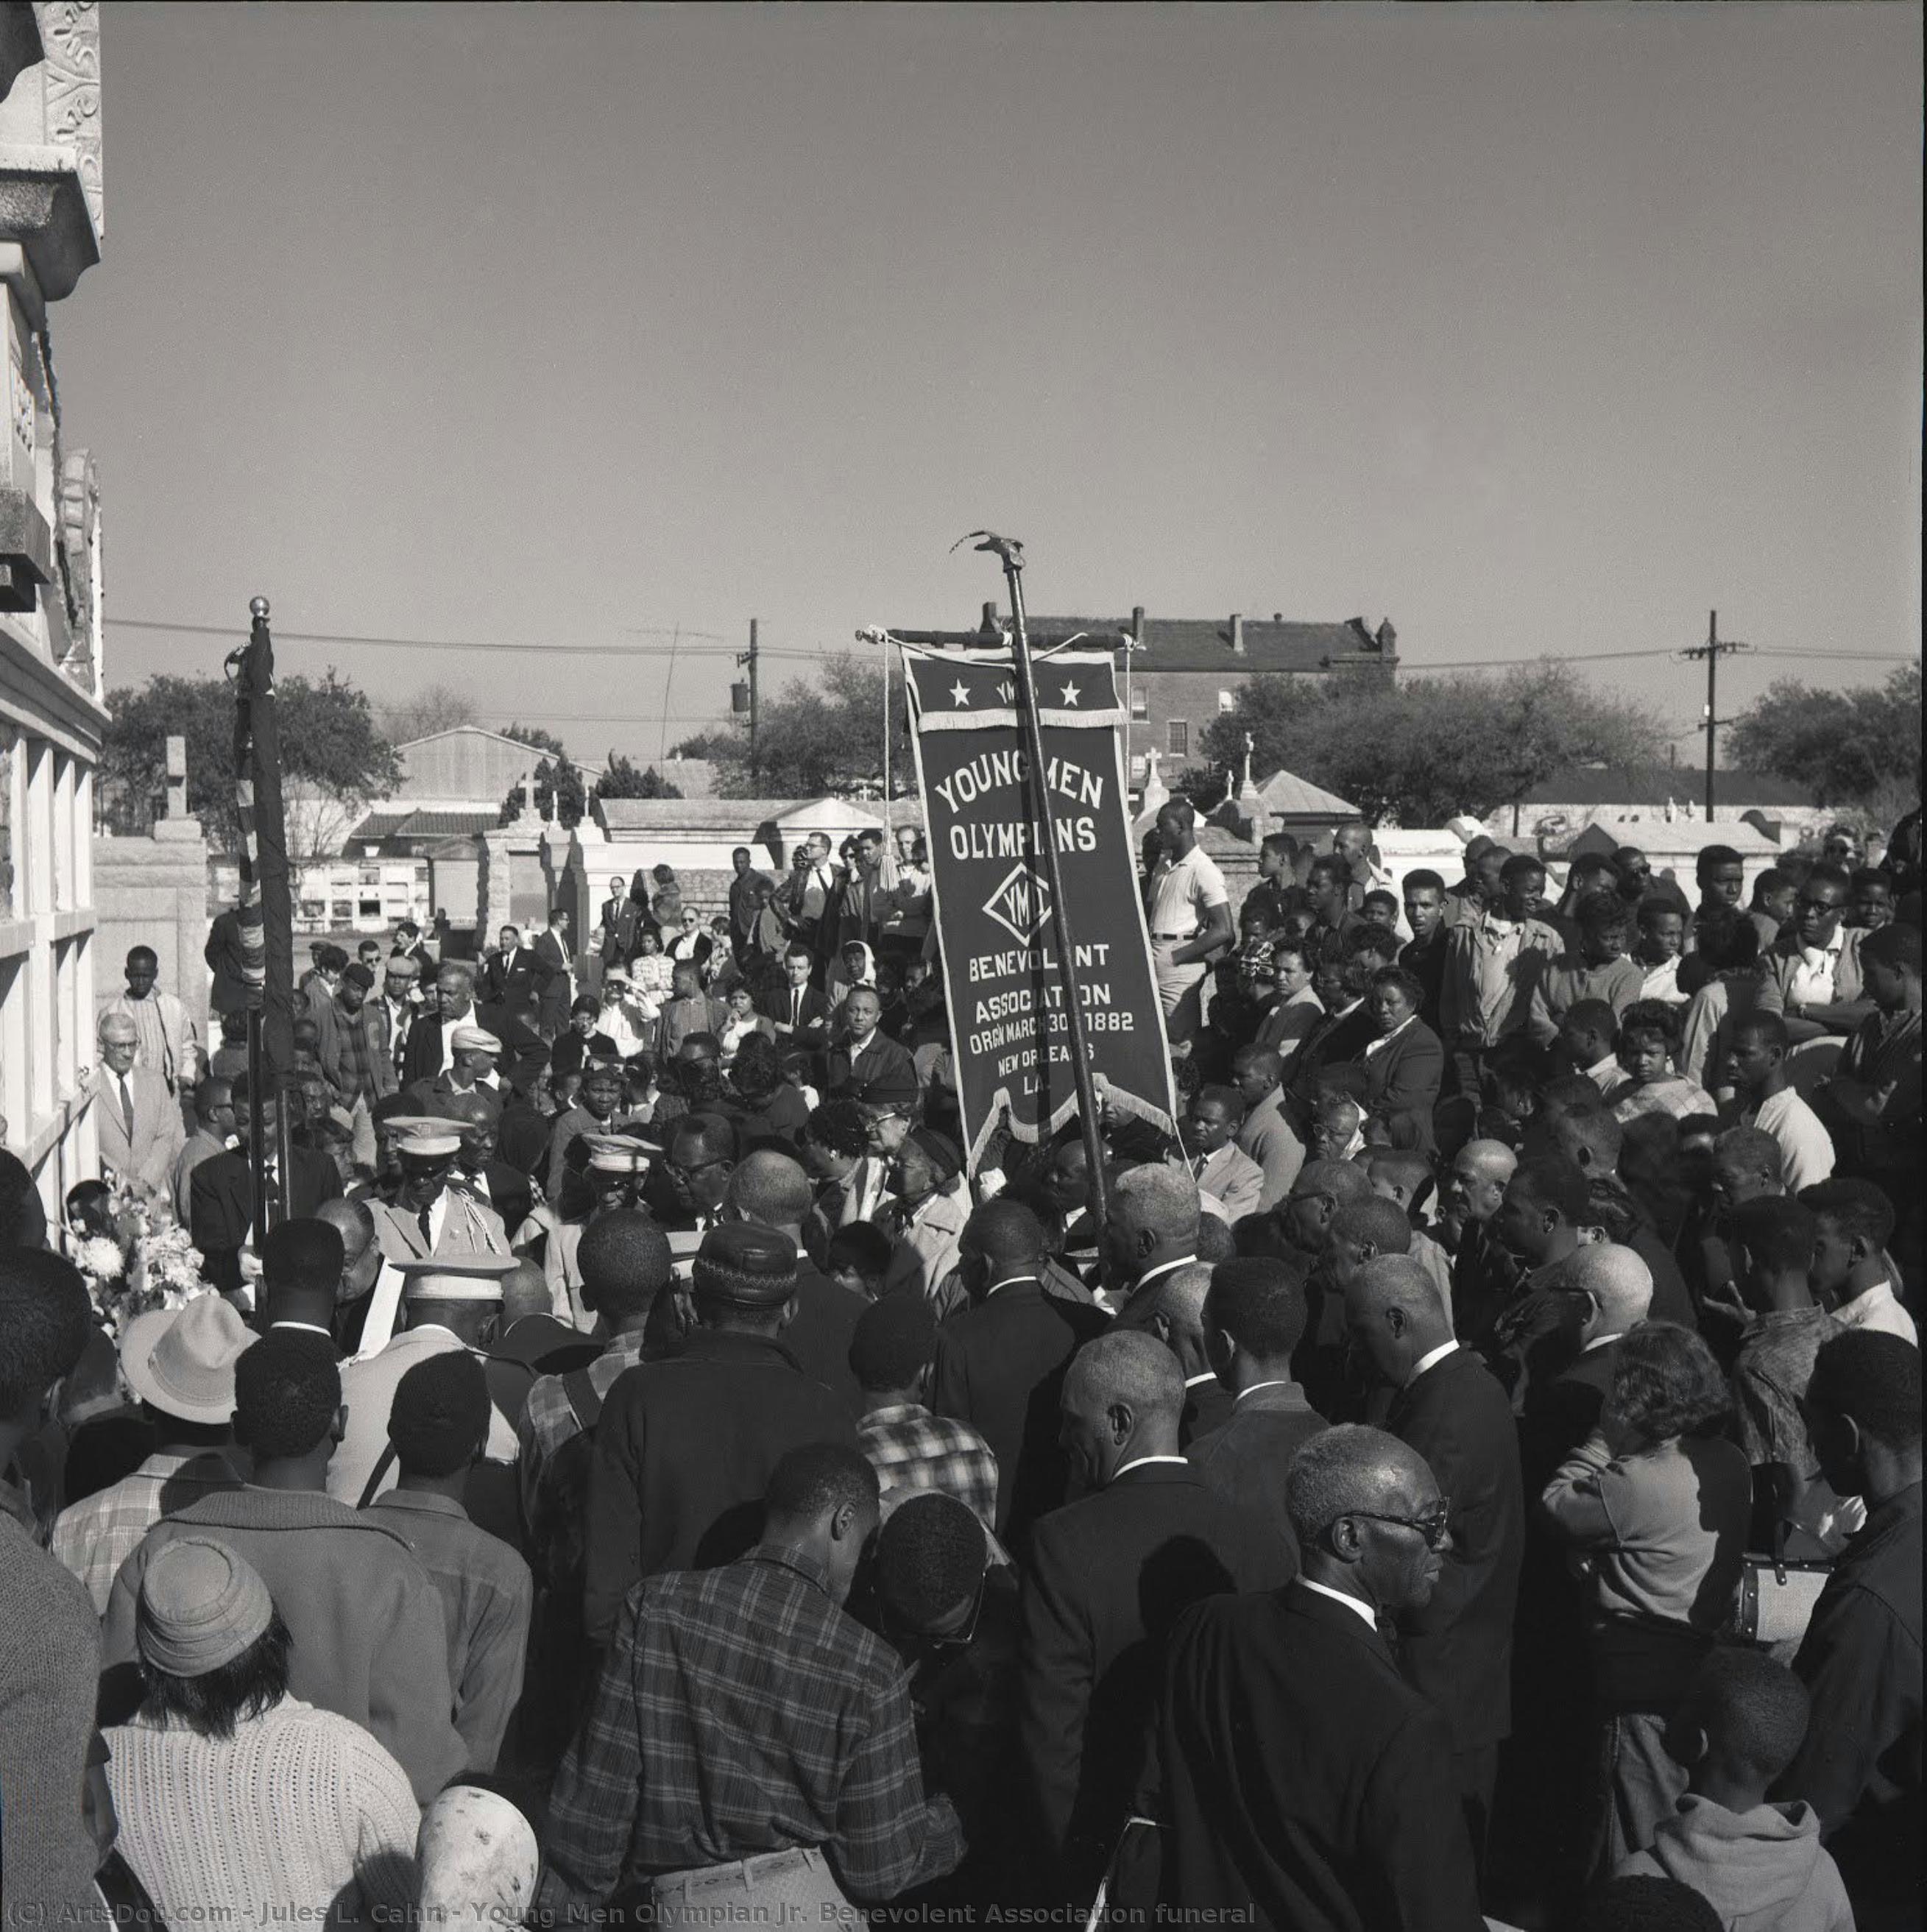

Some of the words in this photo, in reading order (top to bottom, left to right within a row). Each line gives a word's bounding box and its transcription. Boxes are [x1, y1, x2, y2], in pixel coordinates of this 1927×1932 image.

[935, 749, 1030, 813] YOUNG
[950, 816, 1096, 860] OLYMPINS
[969, 944, 1109, 983] BENEVOLNT
[975, 983, 1111, 1024] ASSOCIATON
[1005, 1016, 1047, 1043] MARCH
[1049, 1013, 1067, 1033] 30
[1084, 1011, 1134, 1031] 1882
[998, 1053, 1019, 1078] NEW
[1022, 1042, 1095, 1067] ORLEAS
